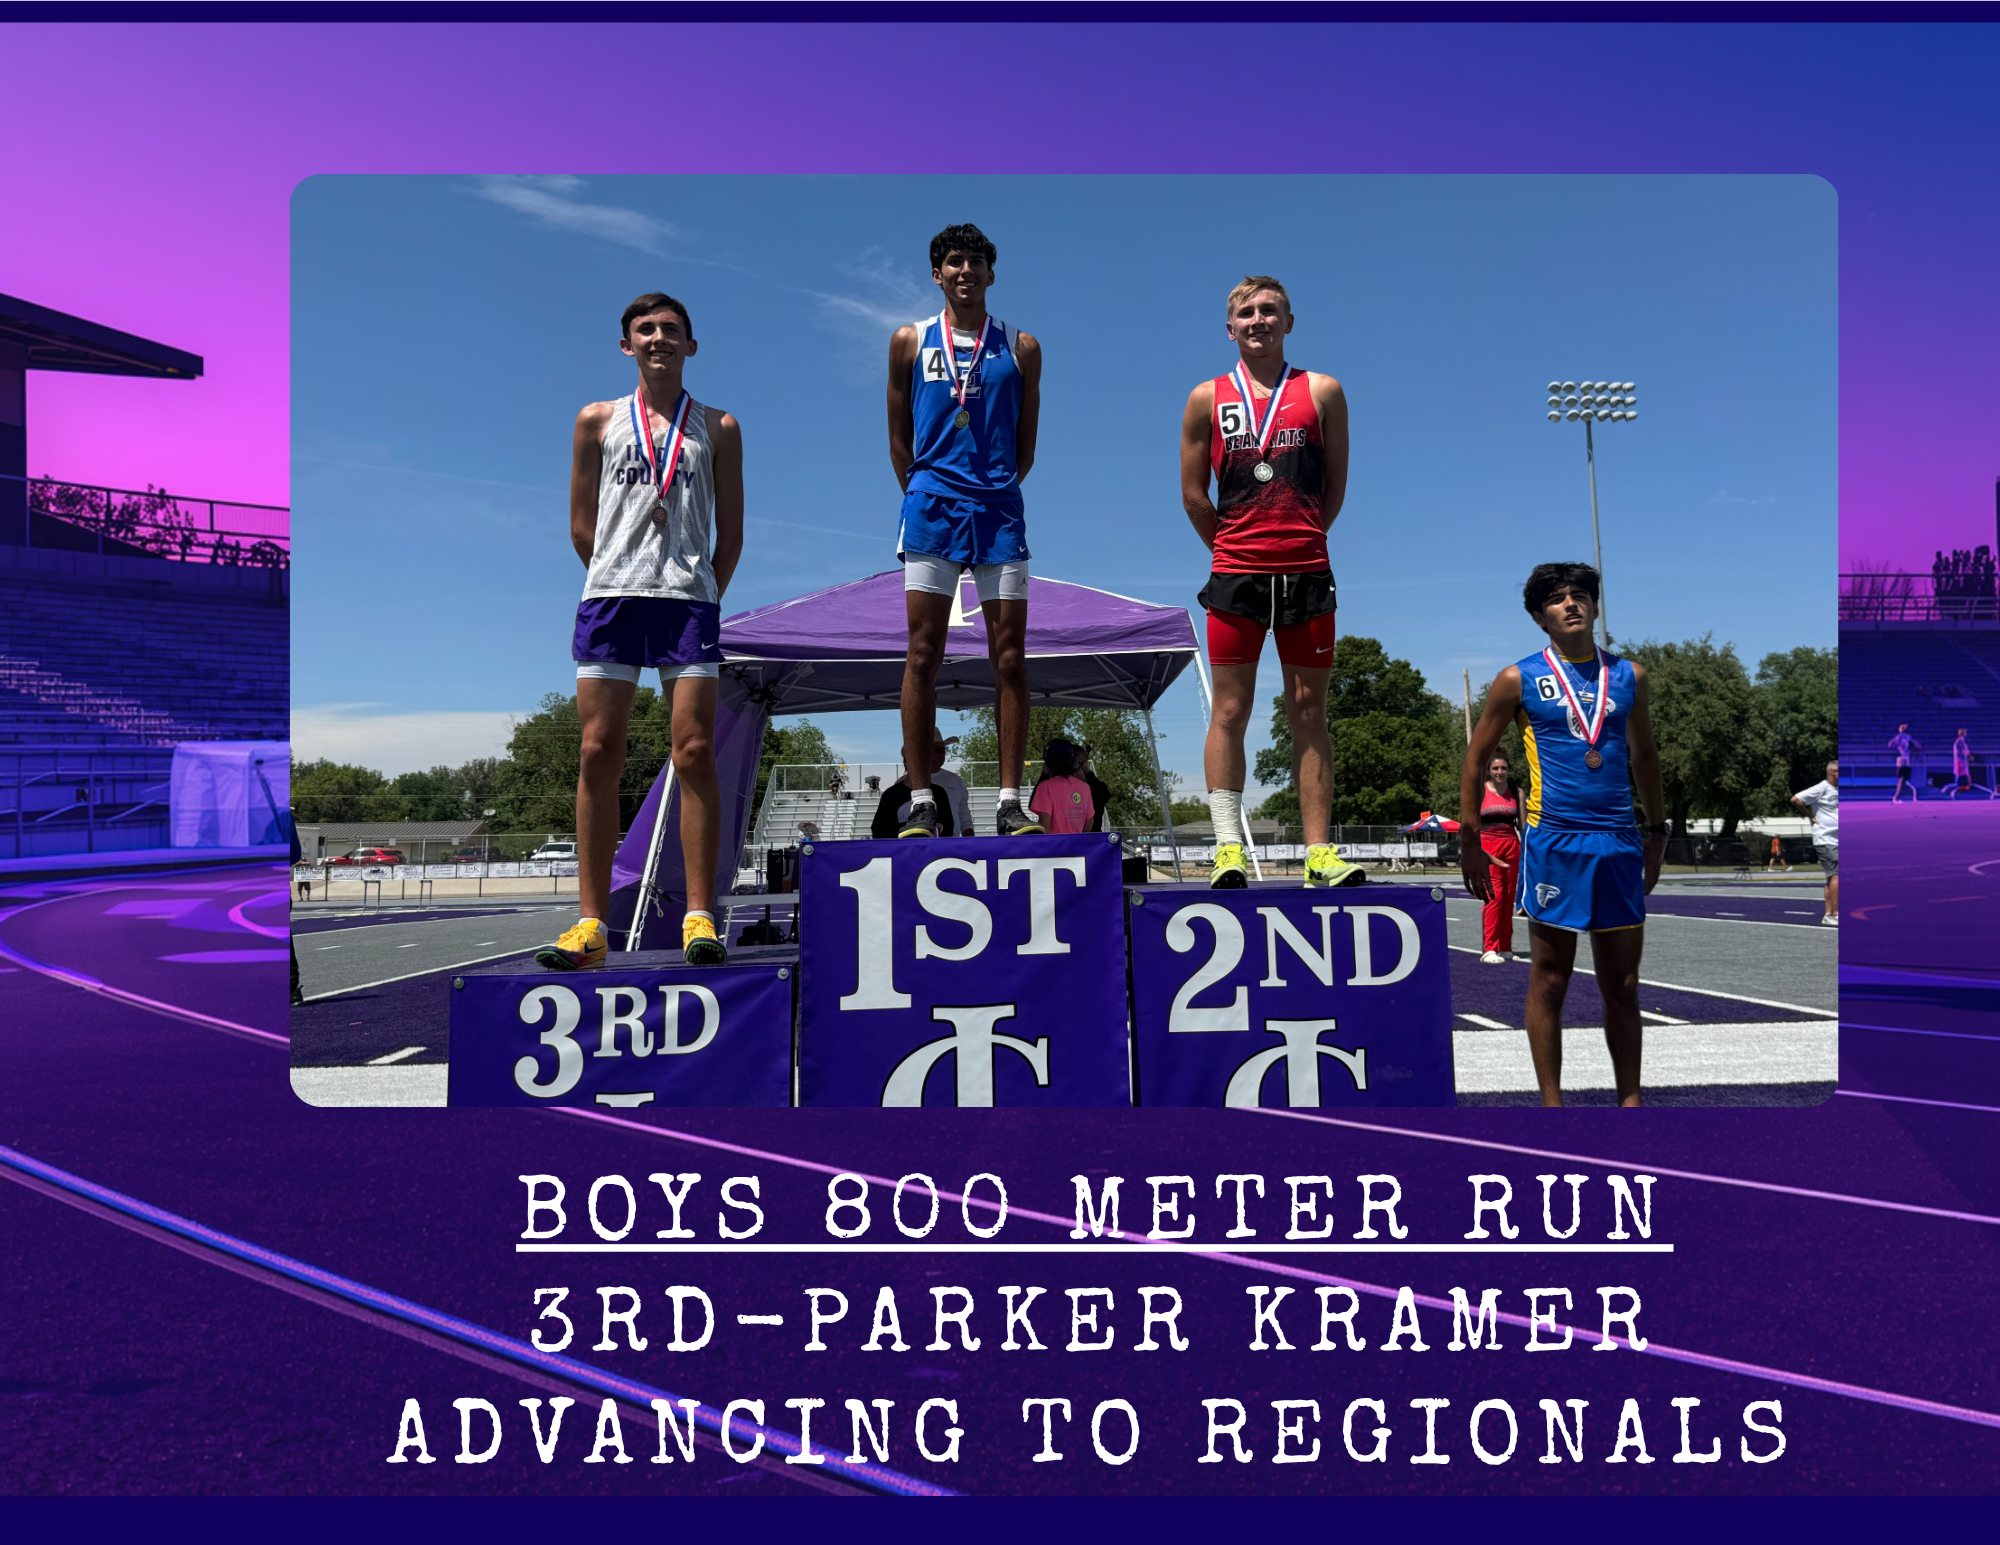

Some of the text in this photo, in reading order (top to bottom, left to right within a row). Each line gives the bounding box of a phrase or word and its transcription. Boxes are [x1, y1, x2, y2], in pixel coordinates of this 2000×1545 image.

[927, 349, 946, 379] 4
[1221, 404, 1241, 435] 5
[1225, 427, 1307, 453] BEAATS
[616, 467, 696, 489] COUTY
[1538, 677, 1556, 699] 6
[839, 856, 1087, 1011] 1ST
[1165, 902, 1422, 1034] 2ND
[513, 984, 721, 1098] 3RD
